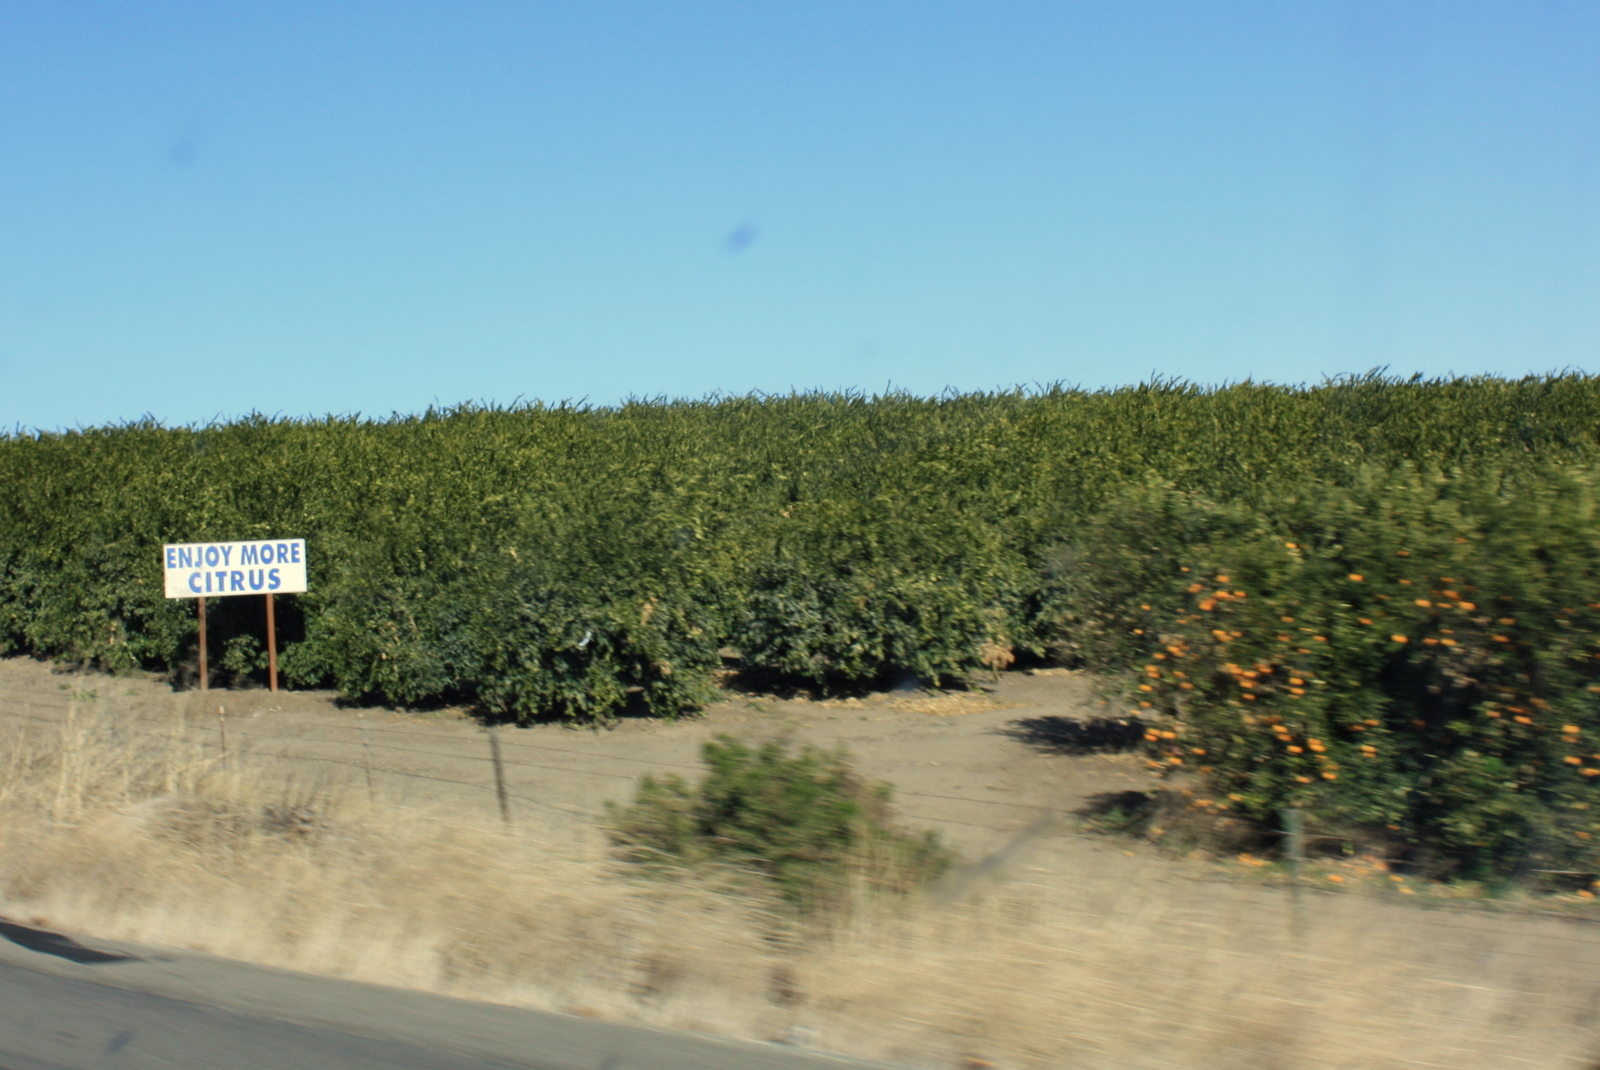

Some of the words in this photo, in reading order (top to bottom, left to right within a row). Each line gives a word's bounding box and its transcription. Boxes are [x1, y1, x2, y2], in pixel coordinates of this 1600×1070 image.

[166, 545, 233, 569] ENJOY
[240, 542, 301, 566] MORE
[188, 568, 281, 593] CITRUS
